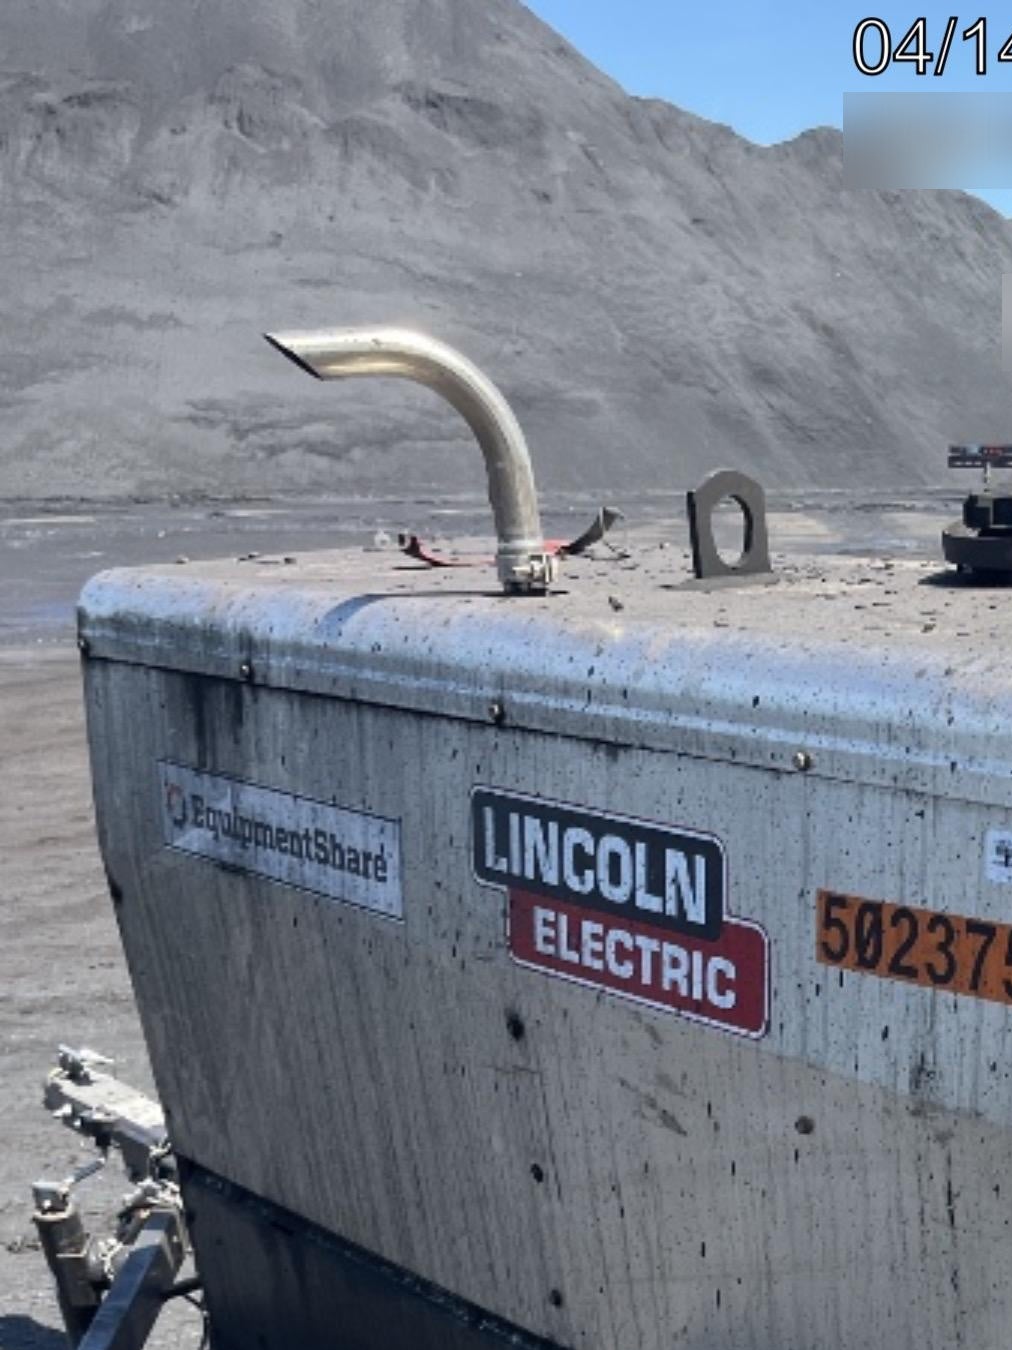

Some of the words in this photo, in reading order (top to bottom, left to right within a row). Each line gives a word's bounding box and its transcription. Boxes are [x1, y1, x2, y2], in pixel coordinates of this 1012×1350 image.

[190, 793, 388, 883] EquipmentShare
[482, 805, 707, 926] LINCOLN
[532, 904, 737, 1010] ELECTRIC
